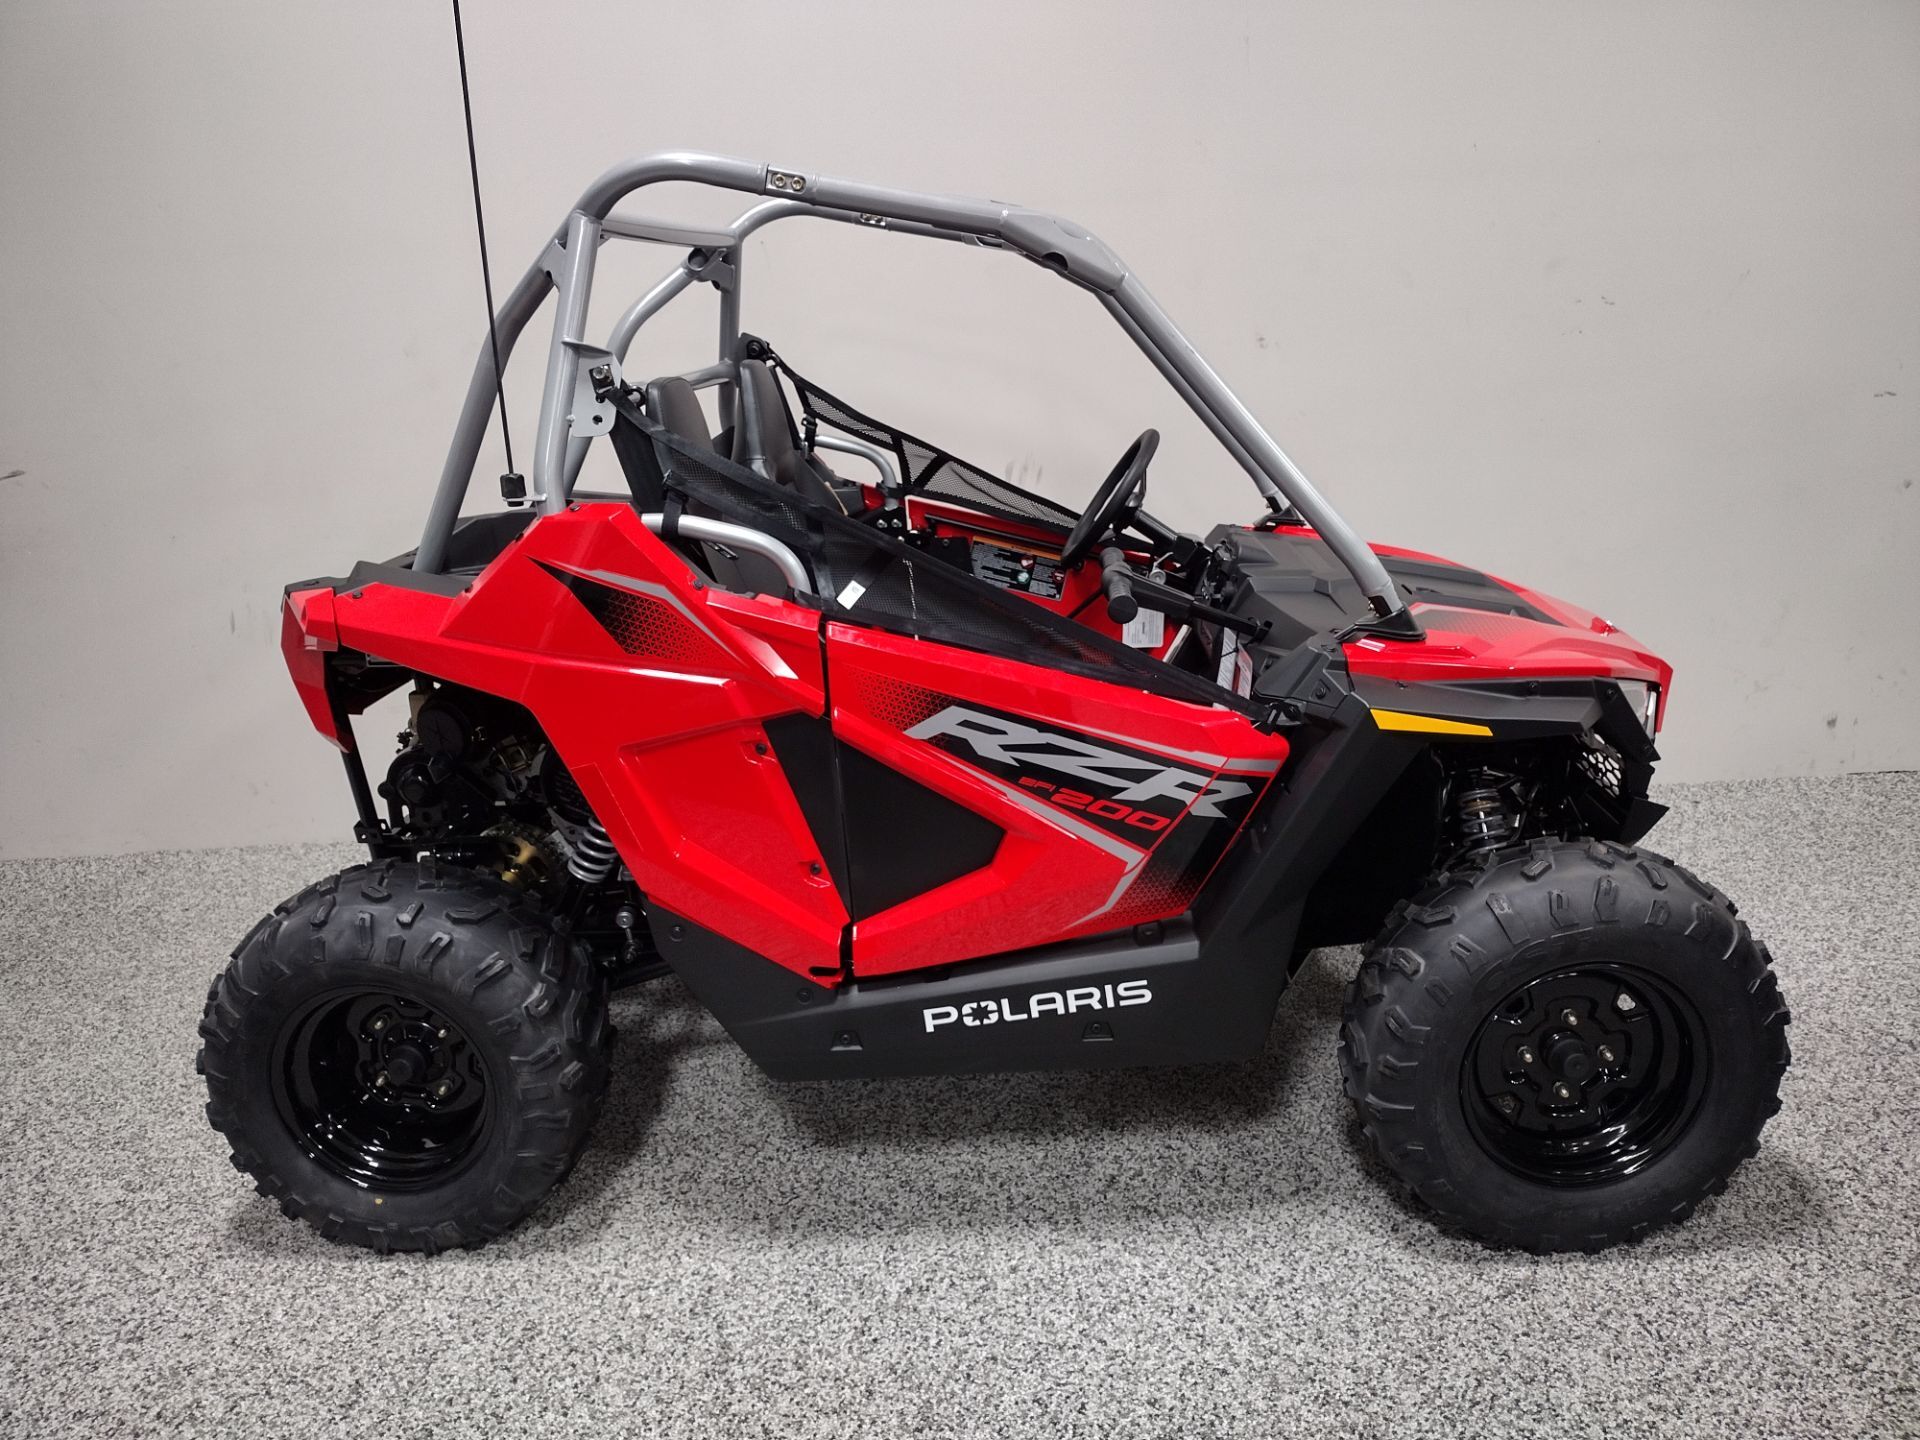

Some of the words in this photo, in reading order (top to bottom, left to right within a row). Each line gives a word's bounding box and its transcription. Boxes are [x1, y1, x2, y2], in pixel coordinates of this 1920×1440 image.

[902, 705, 1253, 818] RZR
[1050, 787, 1172, 832] 200
[922, 979, 1153, 1033] POLARIS
